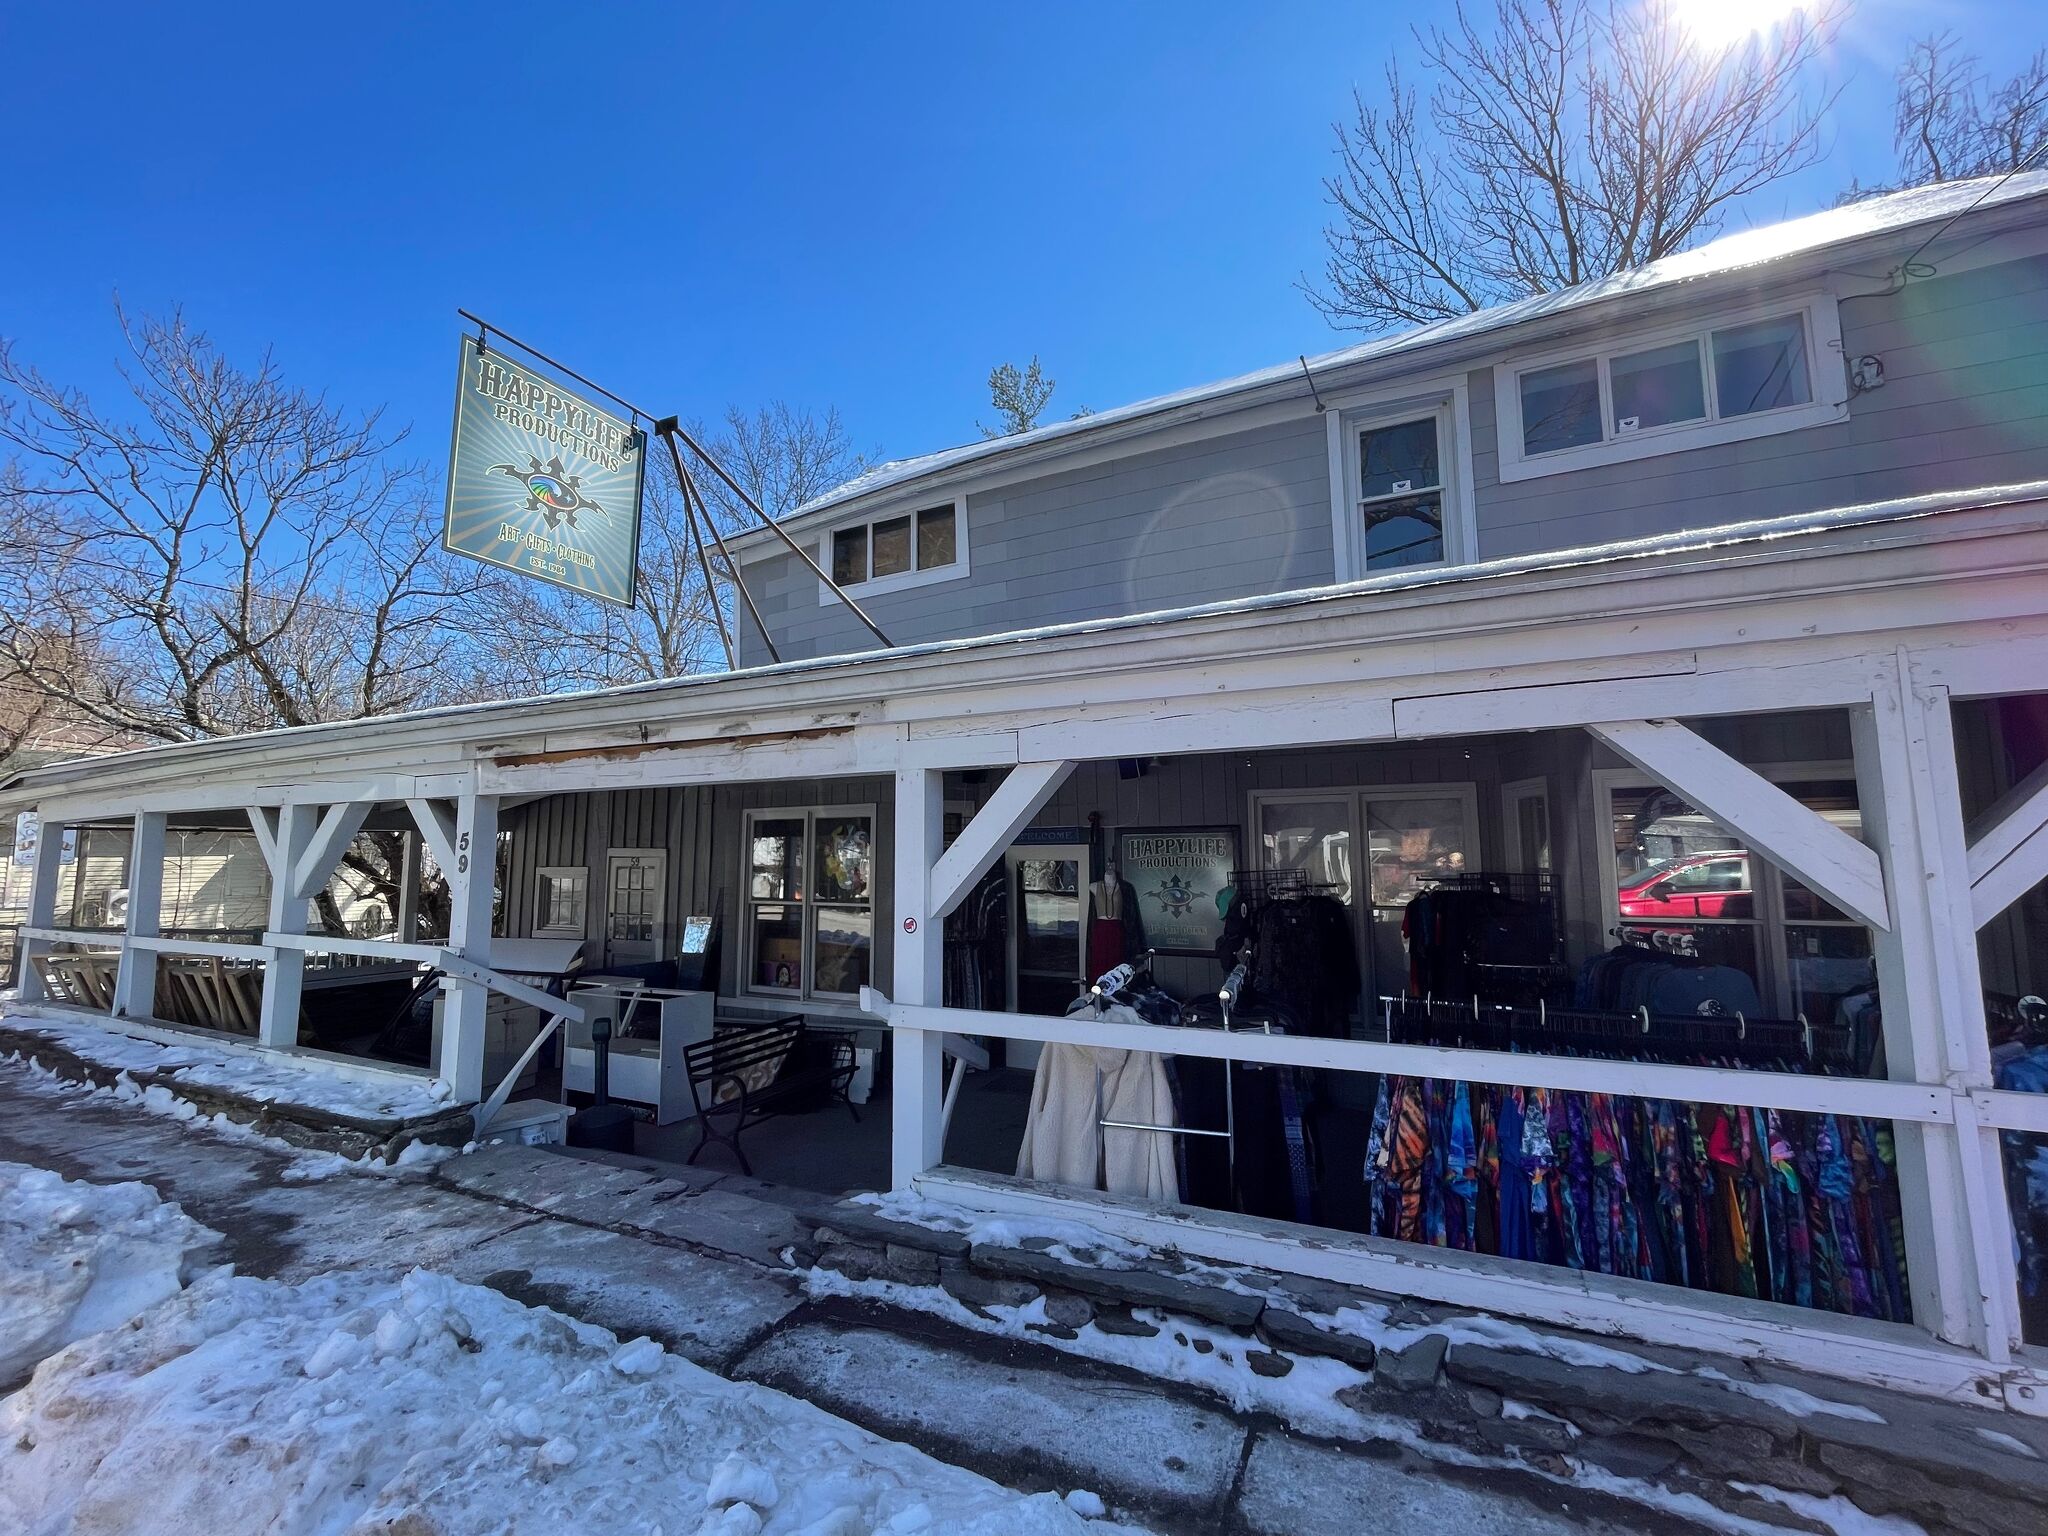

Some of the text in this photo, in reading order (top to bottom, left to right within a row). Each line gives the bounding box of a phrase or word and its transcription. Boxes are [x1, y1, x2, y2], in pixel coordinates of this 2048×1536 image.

[476, 359, 633, 463] HAPPYLIFE
[494, 403, 620, 473] PRODUCTIONS
[498, 523, 595, 569] ART GIFTS CLOTHING
[549, 562, 566, 575] 1984
[1128, 838, 1226, 860] HAPPYLIFE
[1139, 856, 1218, 869] PRODUCTIONS
